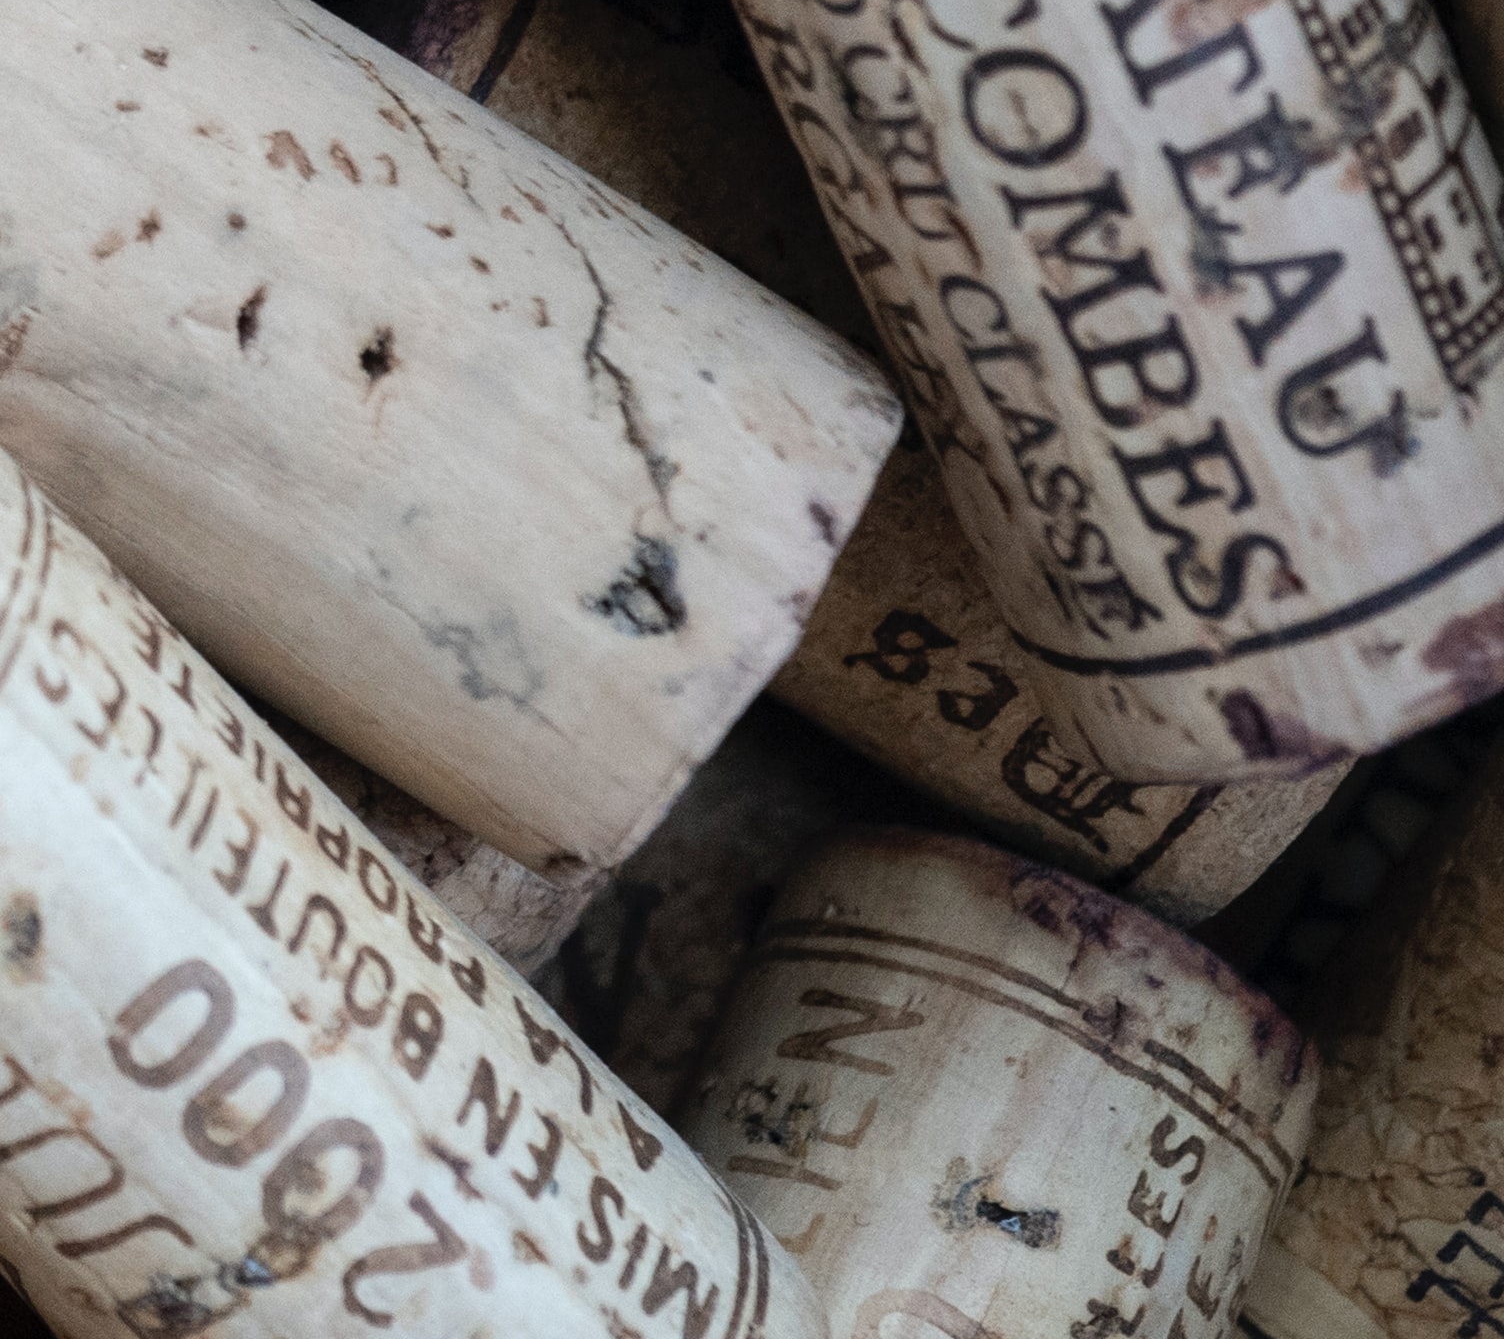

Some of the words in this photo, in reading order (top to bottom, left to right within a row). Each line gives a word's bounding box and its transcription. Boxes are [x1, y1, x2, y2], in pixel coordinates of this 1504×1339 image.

[29, 615, 448, 1083] BOUTEILLES
[106, 956, 470, 1328] 2000
[456, 1056, 568, 1202] EN
